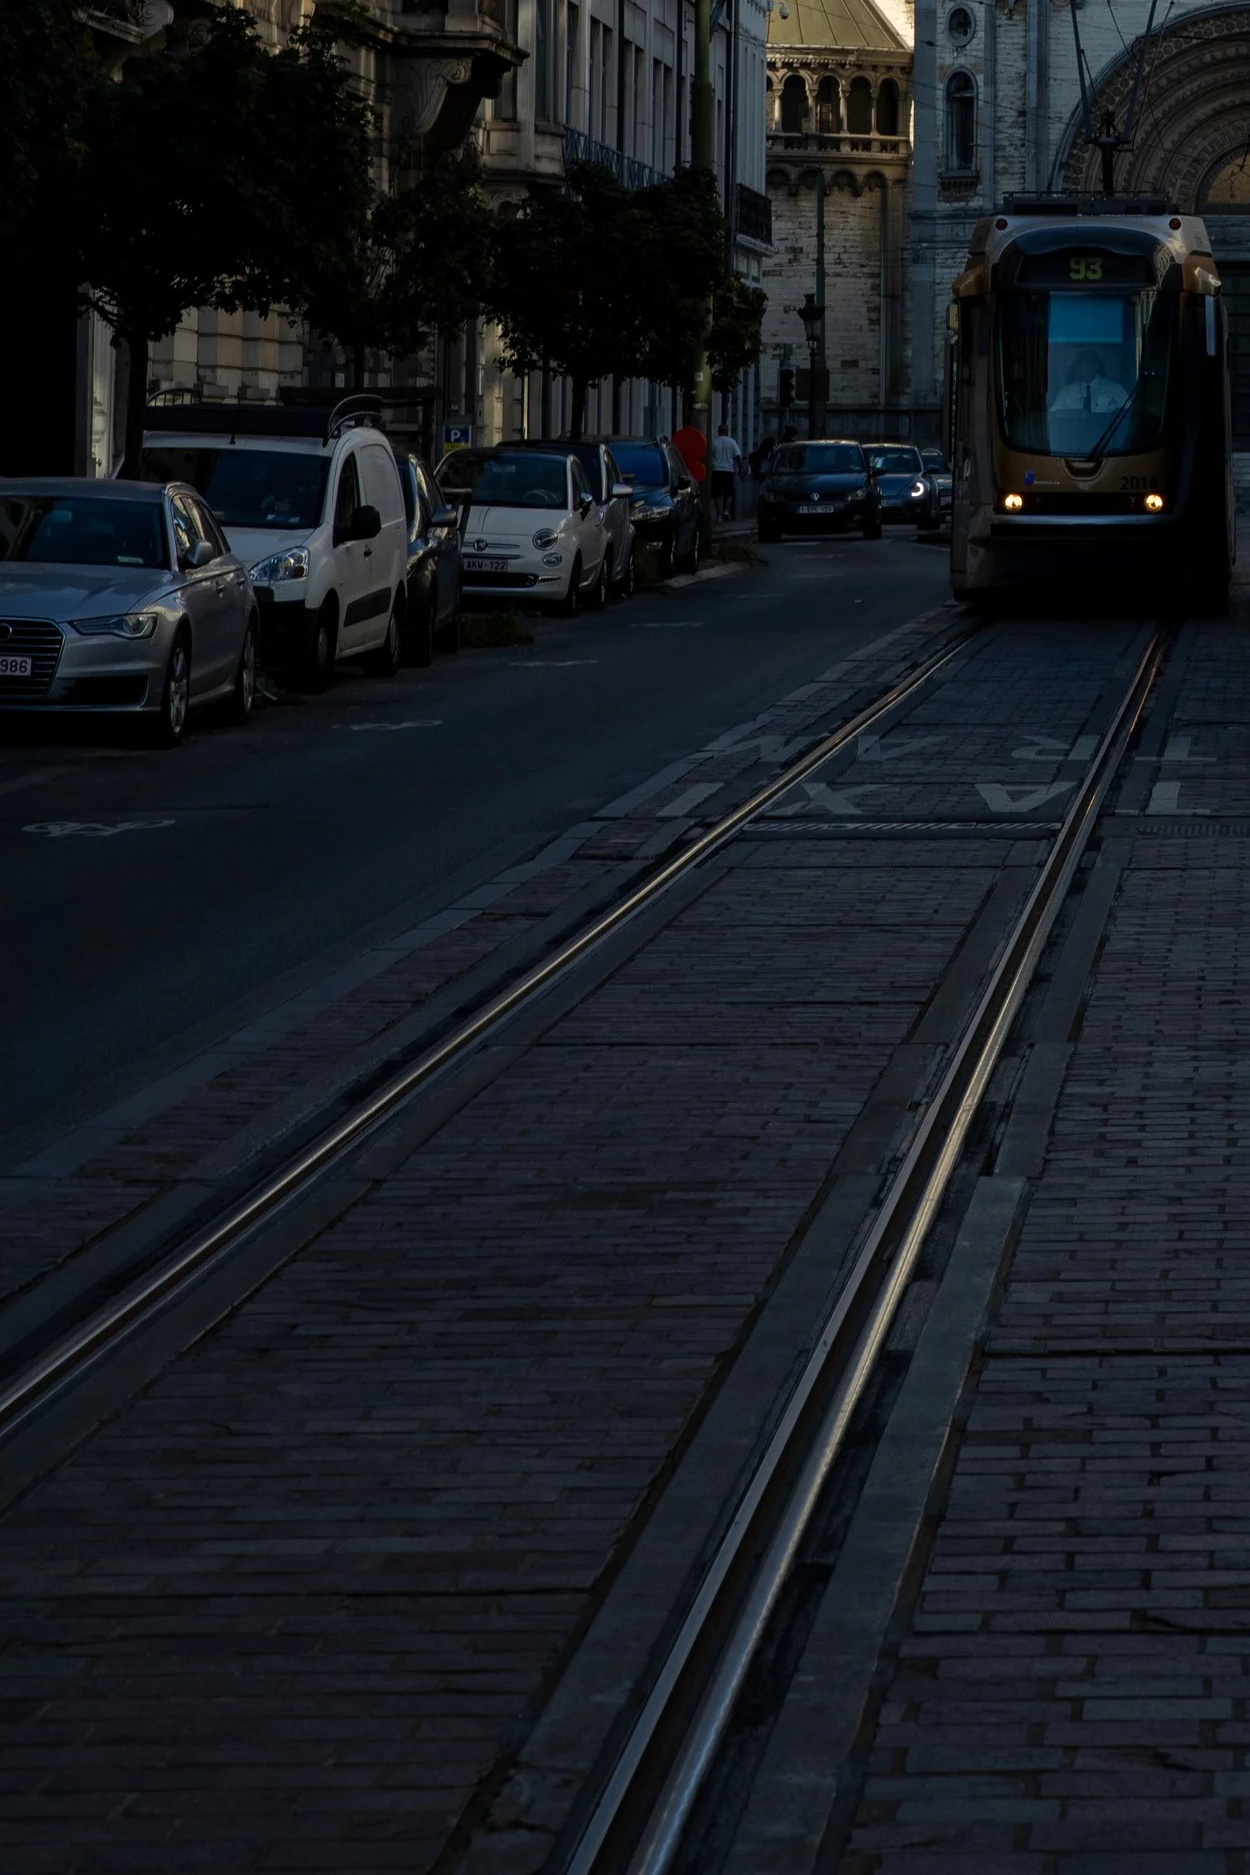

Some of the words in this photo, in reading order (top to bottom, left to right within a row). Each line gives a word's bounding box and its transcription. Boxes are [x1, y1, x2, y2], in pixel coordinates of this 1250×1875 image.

[1069, 256, 1103, 280] 93
[450, 429, 461, 442] P
[1120, 476, 1158, 491] 2016
[656, 782, 1211, 817] TAXI
